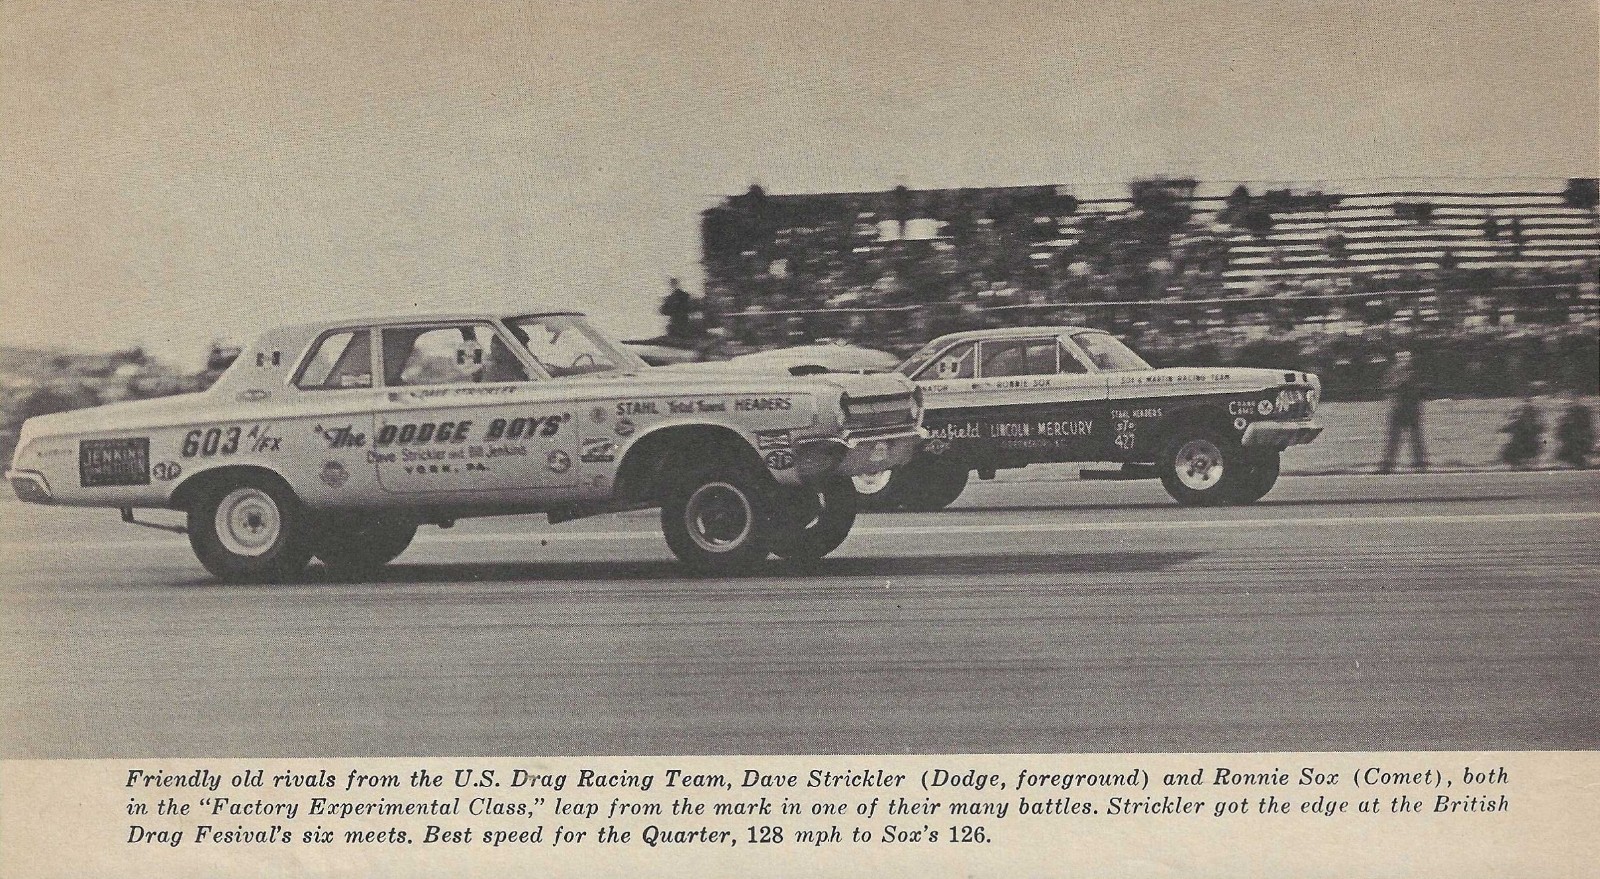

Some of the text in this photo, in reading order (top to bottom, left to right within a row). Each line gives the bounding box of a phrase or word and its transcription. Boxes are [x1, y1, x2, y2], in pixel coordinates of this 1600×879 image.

[616, 402, 659, 415] STAHL
[735, 398, 792, 411] HEADERS
[181, 425, 283, 458] 603 A/FX
[378, 421, 473, 445] DODGE
[1114, 434, 1136, 449] 427
[82, 448, 146, 466] JENKINS
[367, 450, 397, 463] Dave
[402, 448, 446, 461] Strickler
[486, 445, 528, 459] Jenkins
[769, 451, 794, 468] STP
[154, 462, 181, 479] STP
